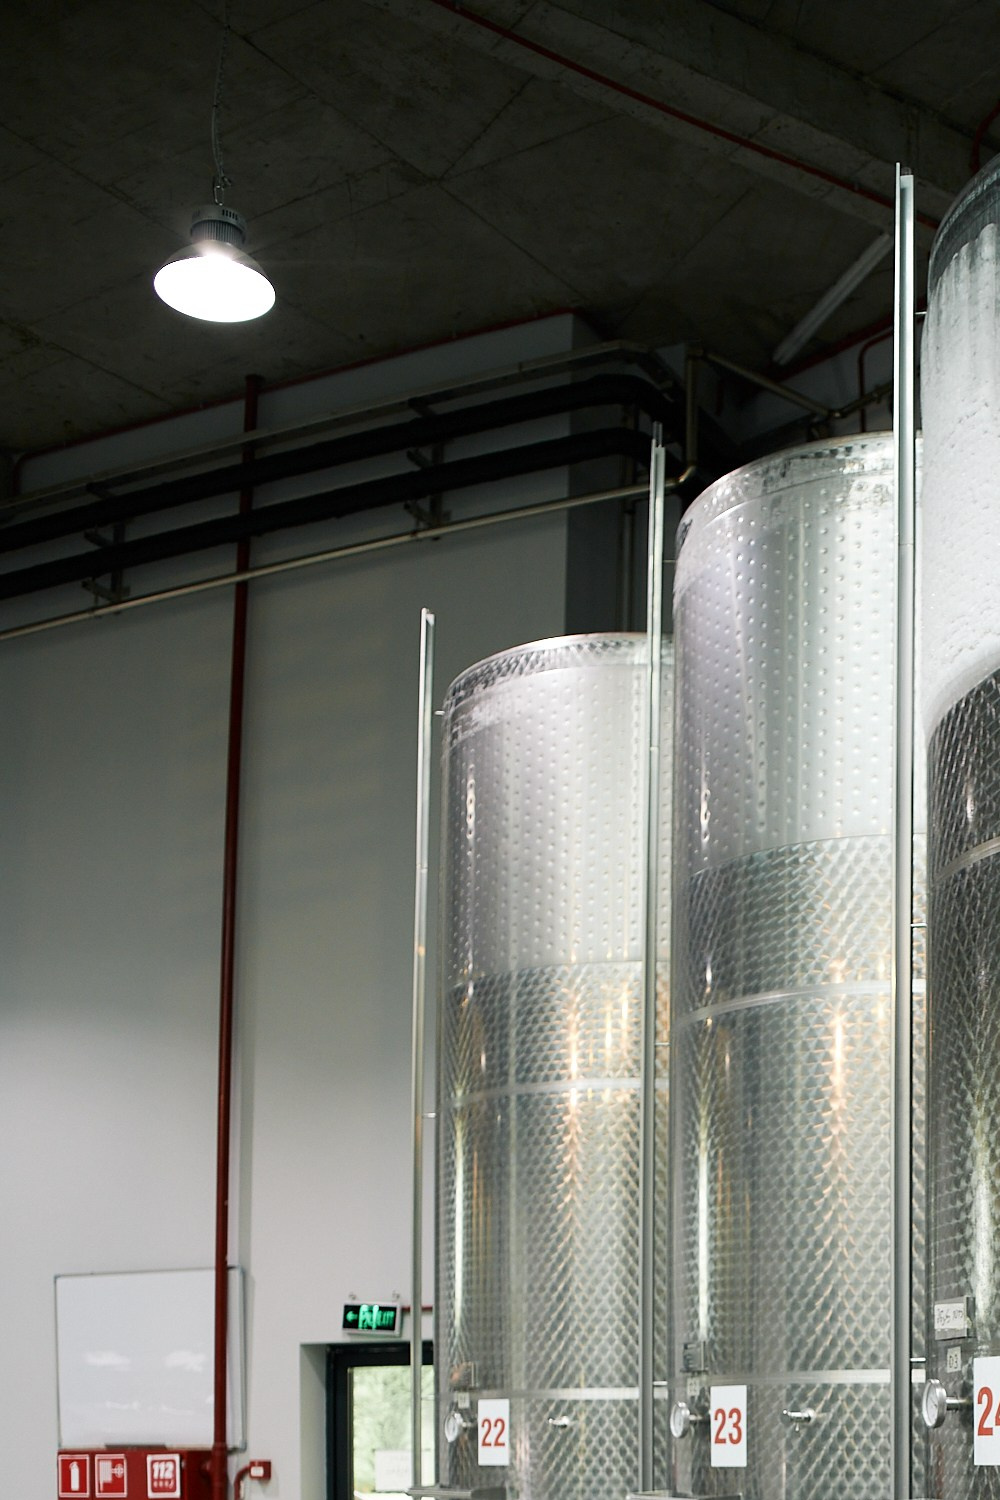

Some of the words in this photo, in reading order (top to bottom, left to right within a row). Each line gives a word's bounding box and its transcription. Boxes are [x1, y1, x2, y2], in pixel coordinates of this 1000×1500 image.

[481, 1418, 506, 1447] 22
[714, 1407, 742, 1445] 23
[153, 1461, 174, 1479] 112
